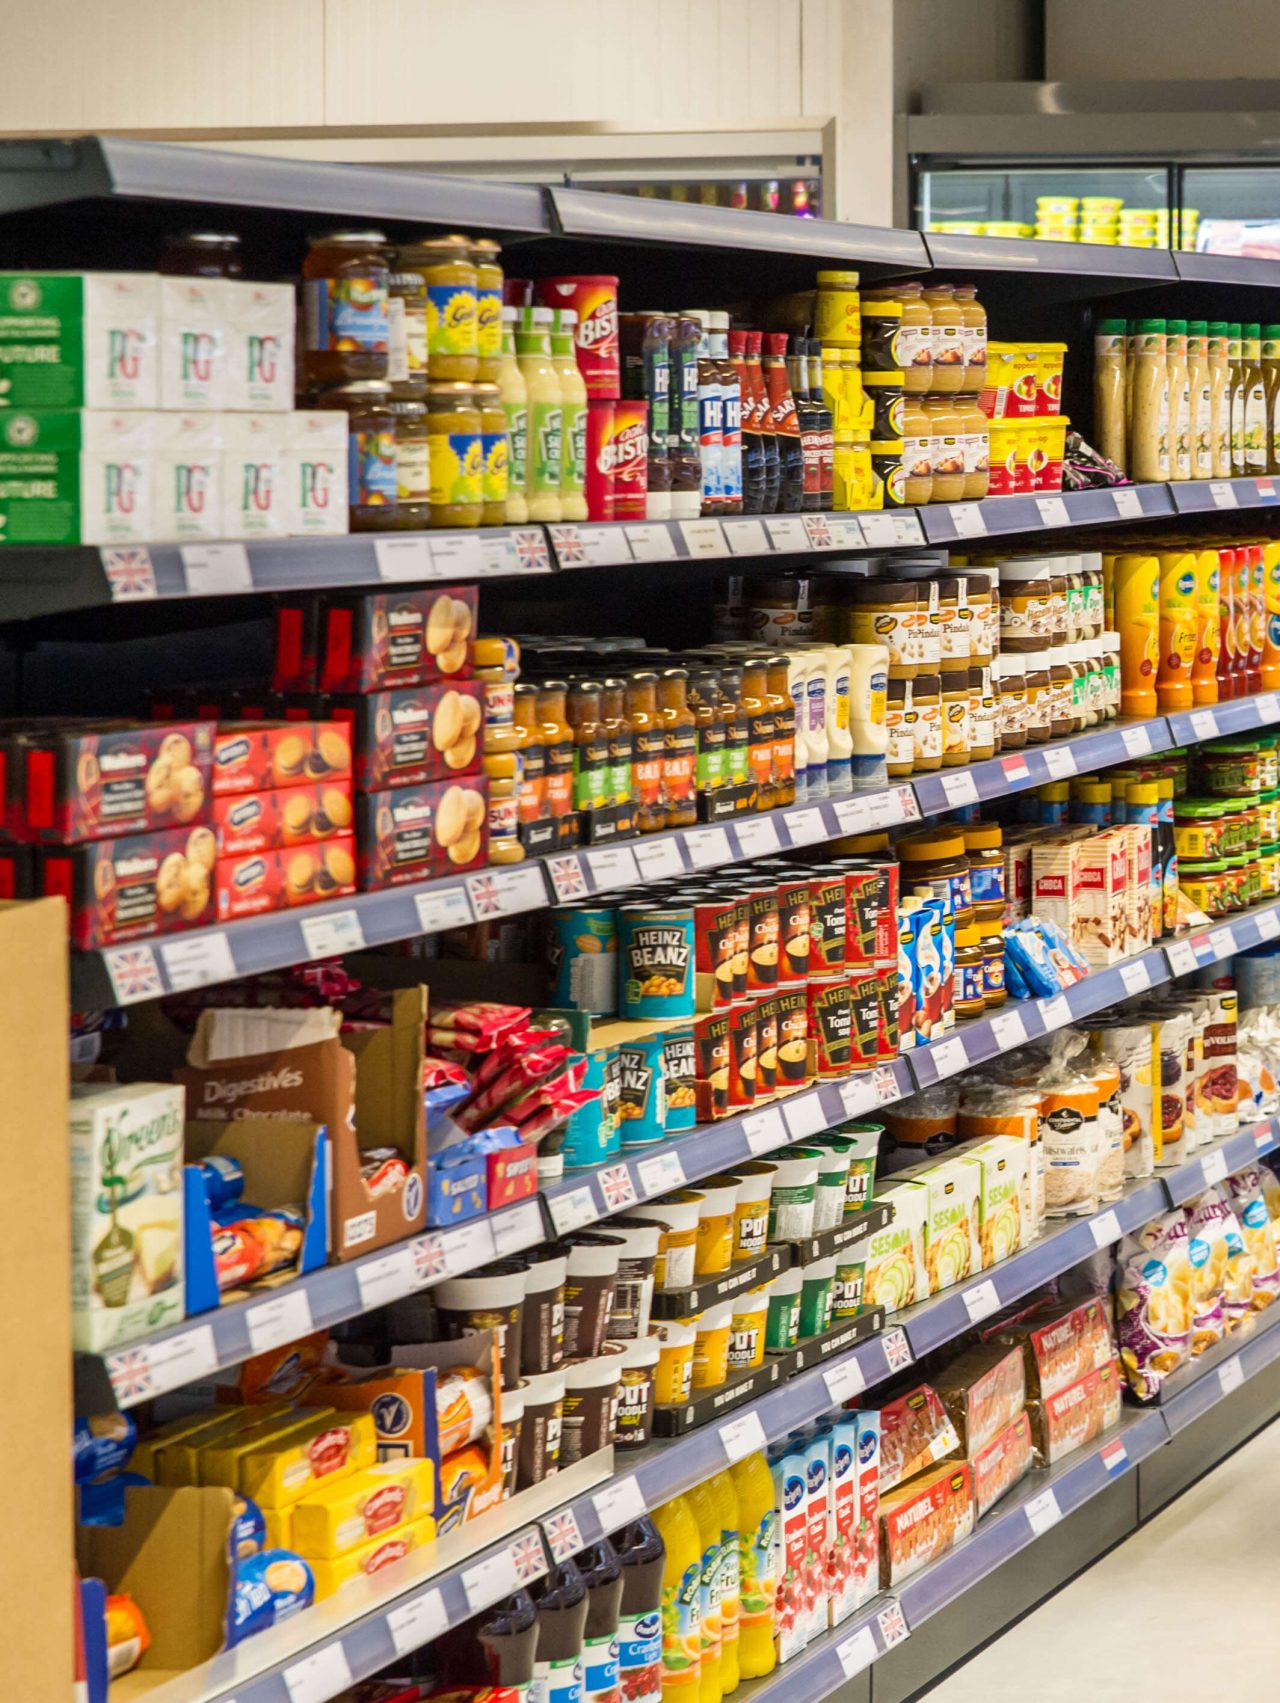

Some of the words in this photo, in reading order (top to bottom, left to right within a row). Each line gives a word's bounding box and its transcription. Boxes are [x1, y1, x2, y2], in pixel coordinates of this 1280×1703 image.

[577, 311, 618, 349] BIST
[108, 329, 143, 380] PG
[181, 331, 215, 382] PG
[247, 334, 277, 383] PG
[105, 463, 138, 514] PG
[174, 463, 208, 513] PG
[243, 462, 272, 511] PG
[301, 462, 333, 509] PG
[631, 945, 689, 968] BEANZ
[639, 930, 681, 946] HEINZ
[203, 1067, 304, 1104] Digestives
[728, 1349, 756, 1361] OODLE
[895, 1495, 935, 1533] NATUREL
